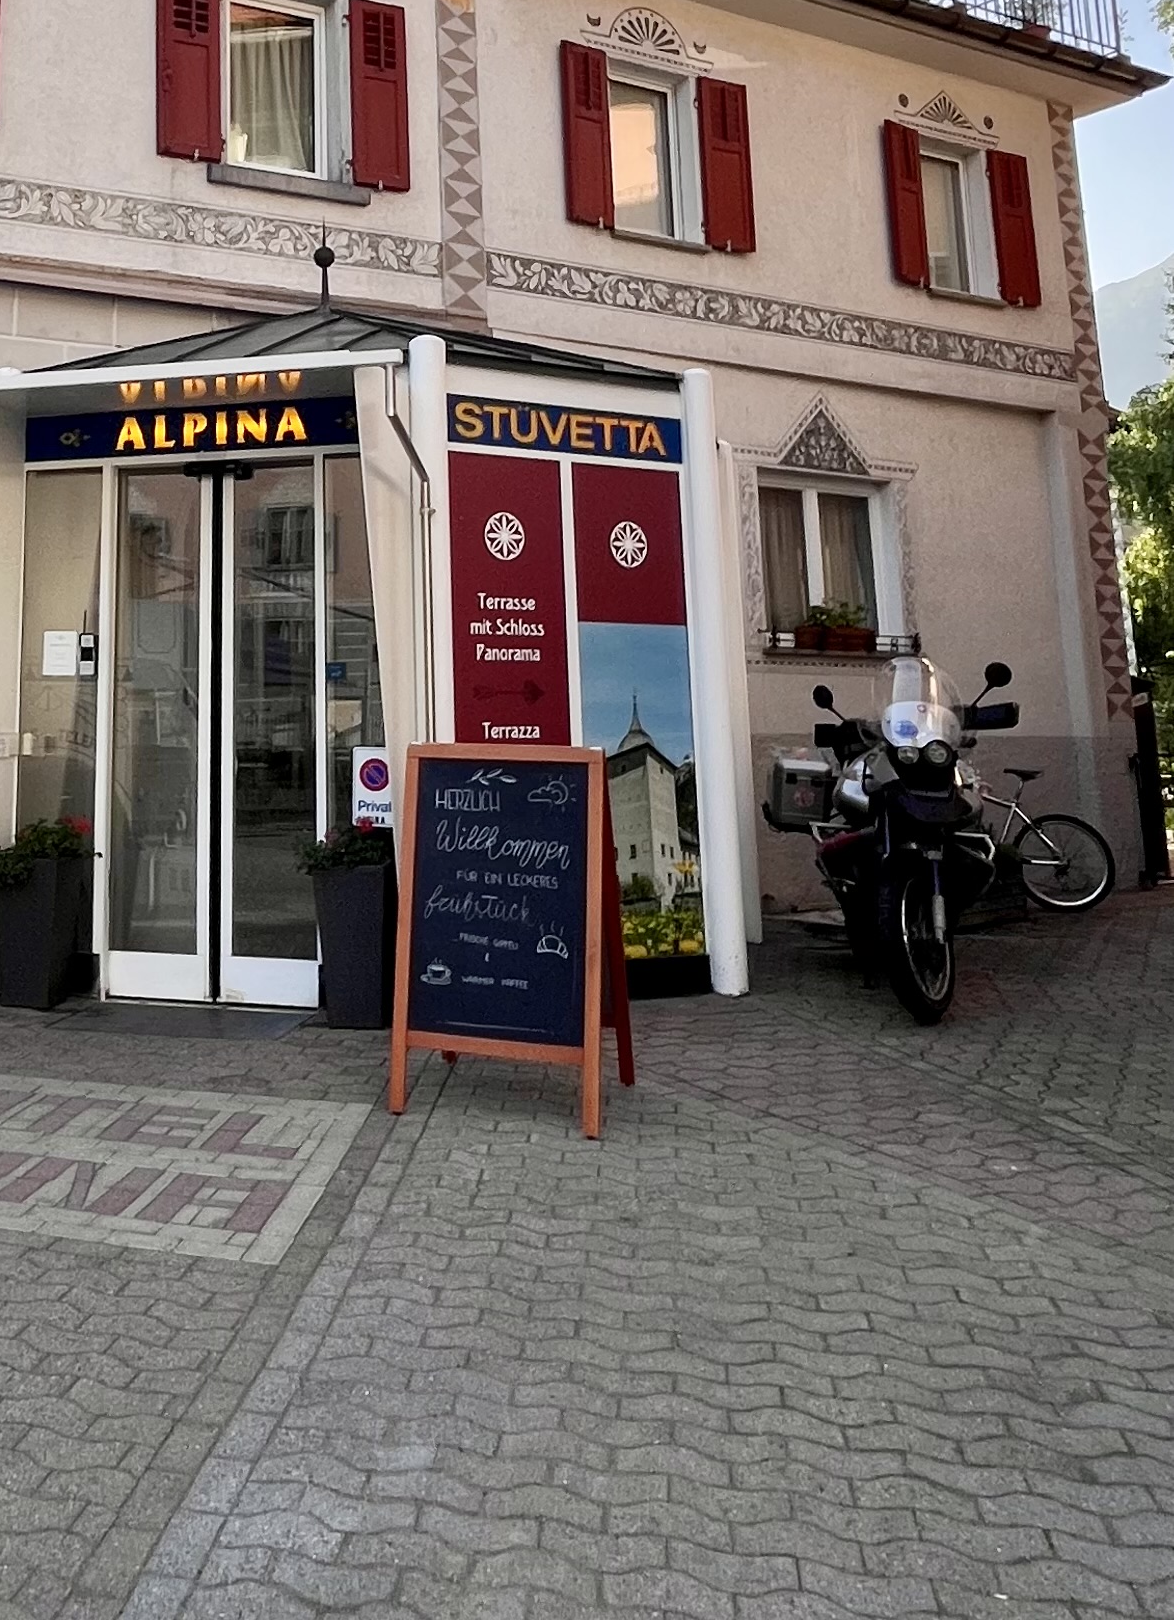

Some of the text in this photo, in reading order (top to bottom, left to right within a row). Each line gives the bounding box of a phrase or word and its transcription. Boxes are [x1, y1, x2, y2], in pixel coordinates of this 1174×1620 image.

[115, 407, 307, 450] ALPINA
[477, 592, 536, 610] Terrasse
[470, 618, 545, 636] mit Schloss
[476, 643, 541, 661] Panorama
[482, 721, 540, 739] Terrazza
[435, 788, 500, 812] HERZLICH
[484, 871, 503, 885] EIN
